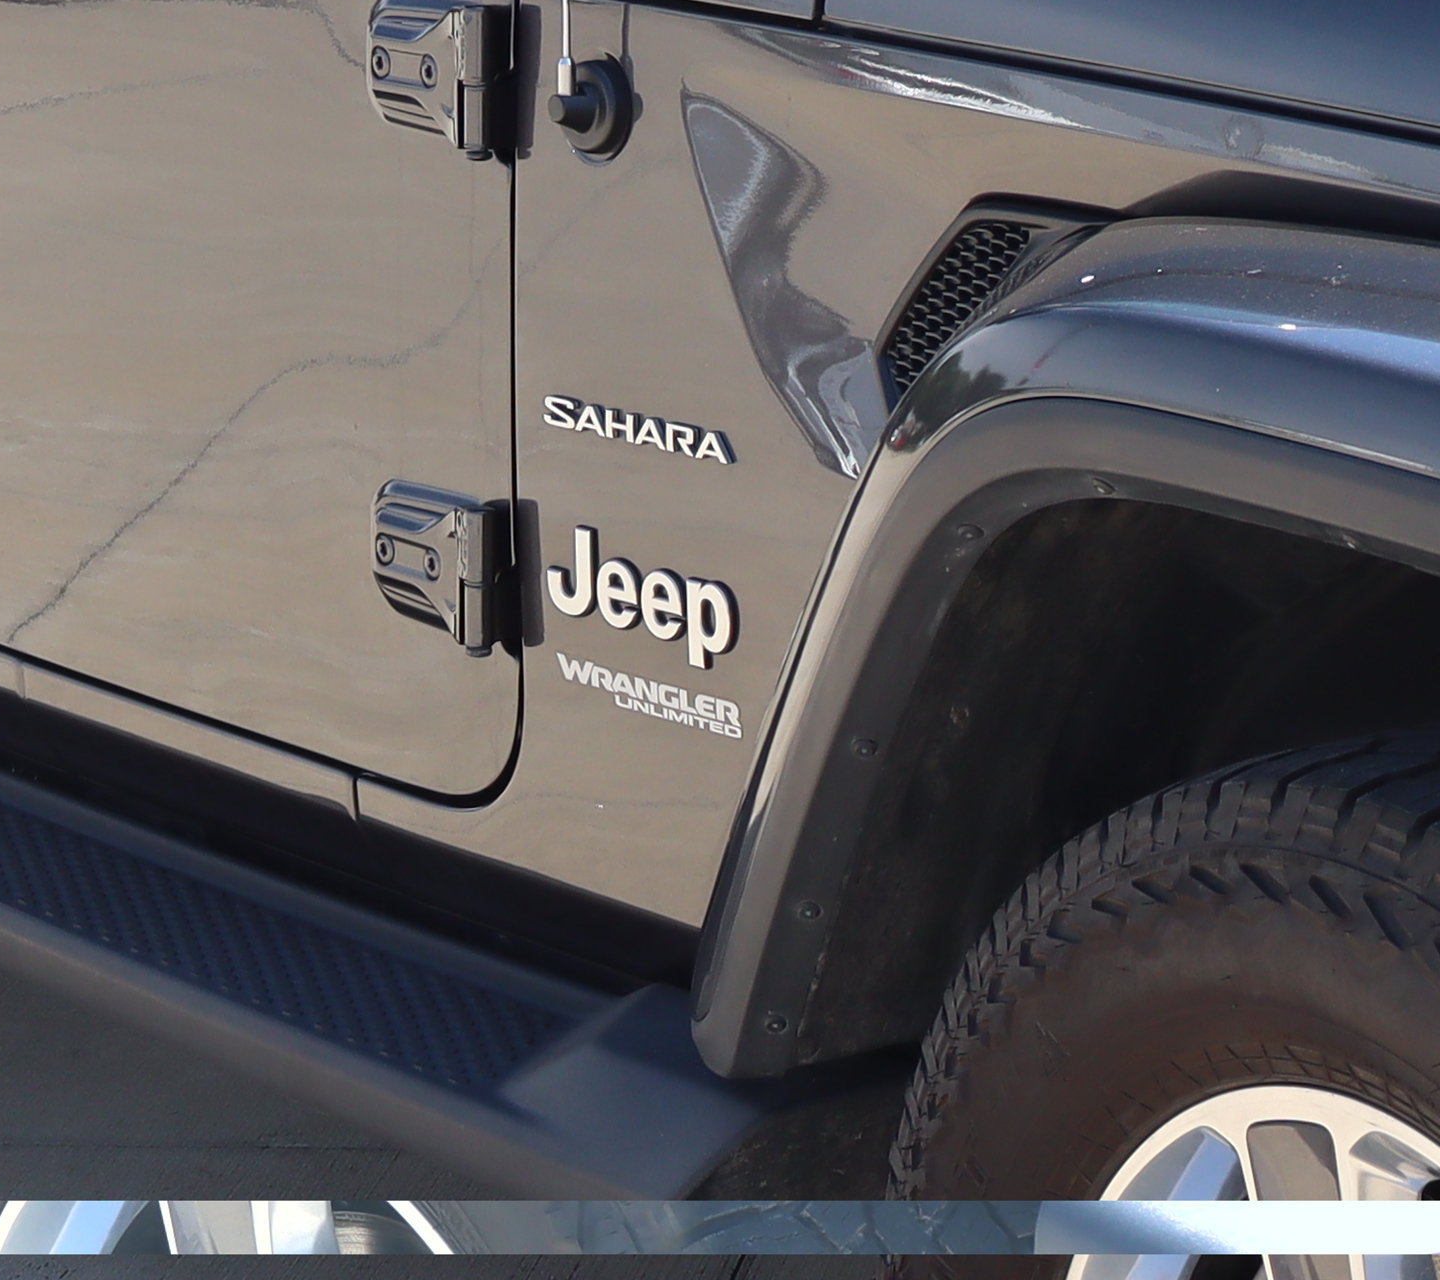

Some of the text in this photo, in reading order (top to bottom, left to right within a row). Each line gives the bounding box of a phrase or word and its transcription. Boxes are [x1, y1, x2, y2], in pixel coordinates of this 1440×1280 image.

[543, 394, 737, 465] SAHARA
[546, 524, 740, 670] Jeep
[555, 652, 742, 727] WRANGLER
[614, 694, 742, 740] UNLIMITED
